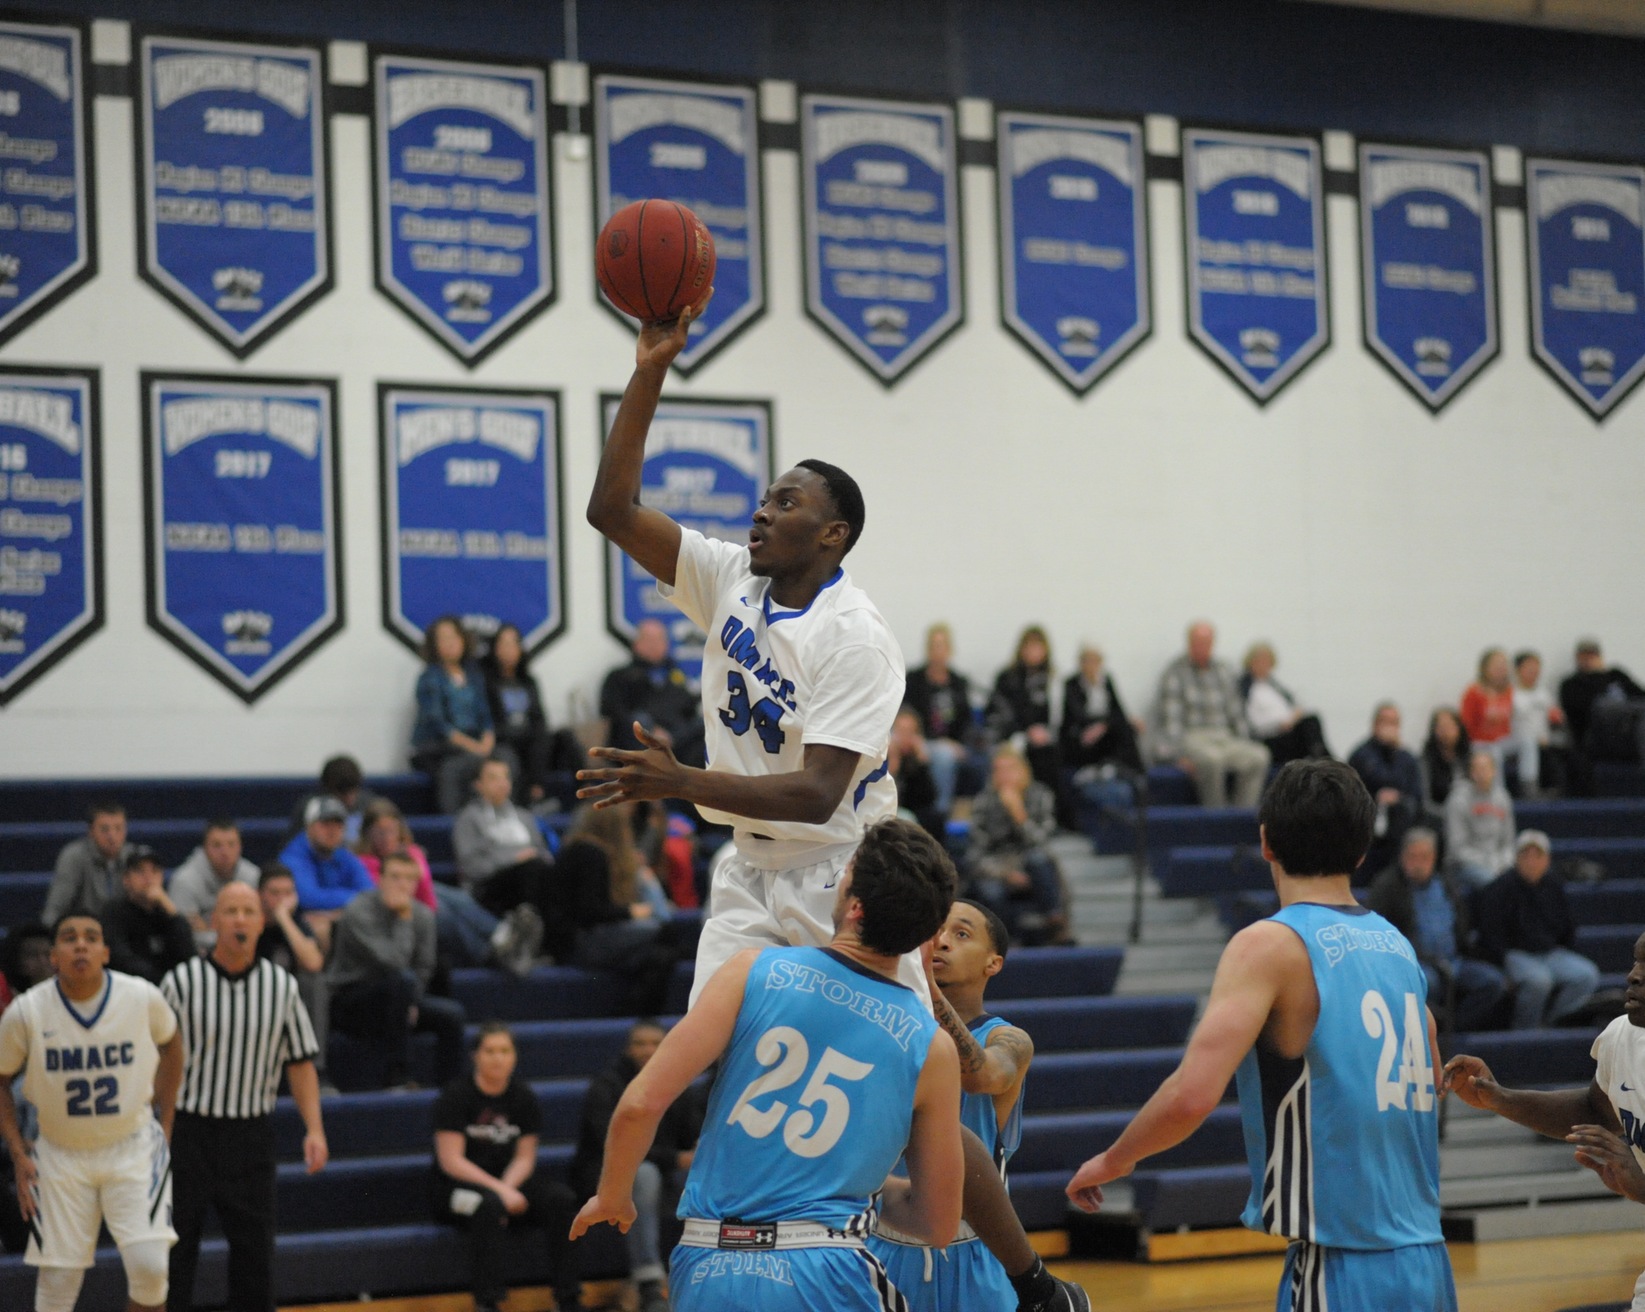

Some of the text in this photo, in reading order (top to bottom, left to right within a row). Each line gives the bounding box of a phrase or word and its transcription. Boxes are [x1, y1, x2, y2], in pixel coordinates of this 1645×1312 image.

[216, 451, 271, 478] 2017
[718, 669, 785, 754] 34
[765, 958, 923, 1052] STORM
[44, 1041, 135, 1072] DMACC
[726, 1025, 875, 1159] 25
[1360, 989, 1434, 1113] 24
[65, 1074, 121, 1117] 22
